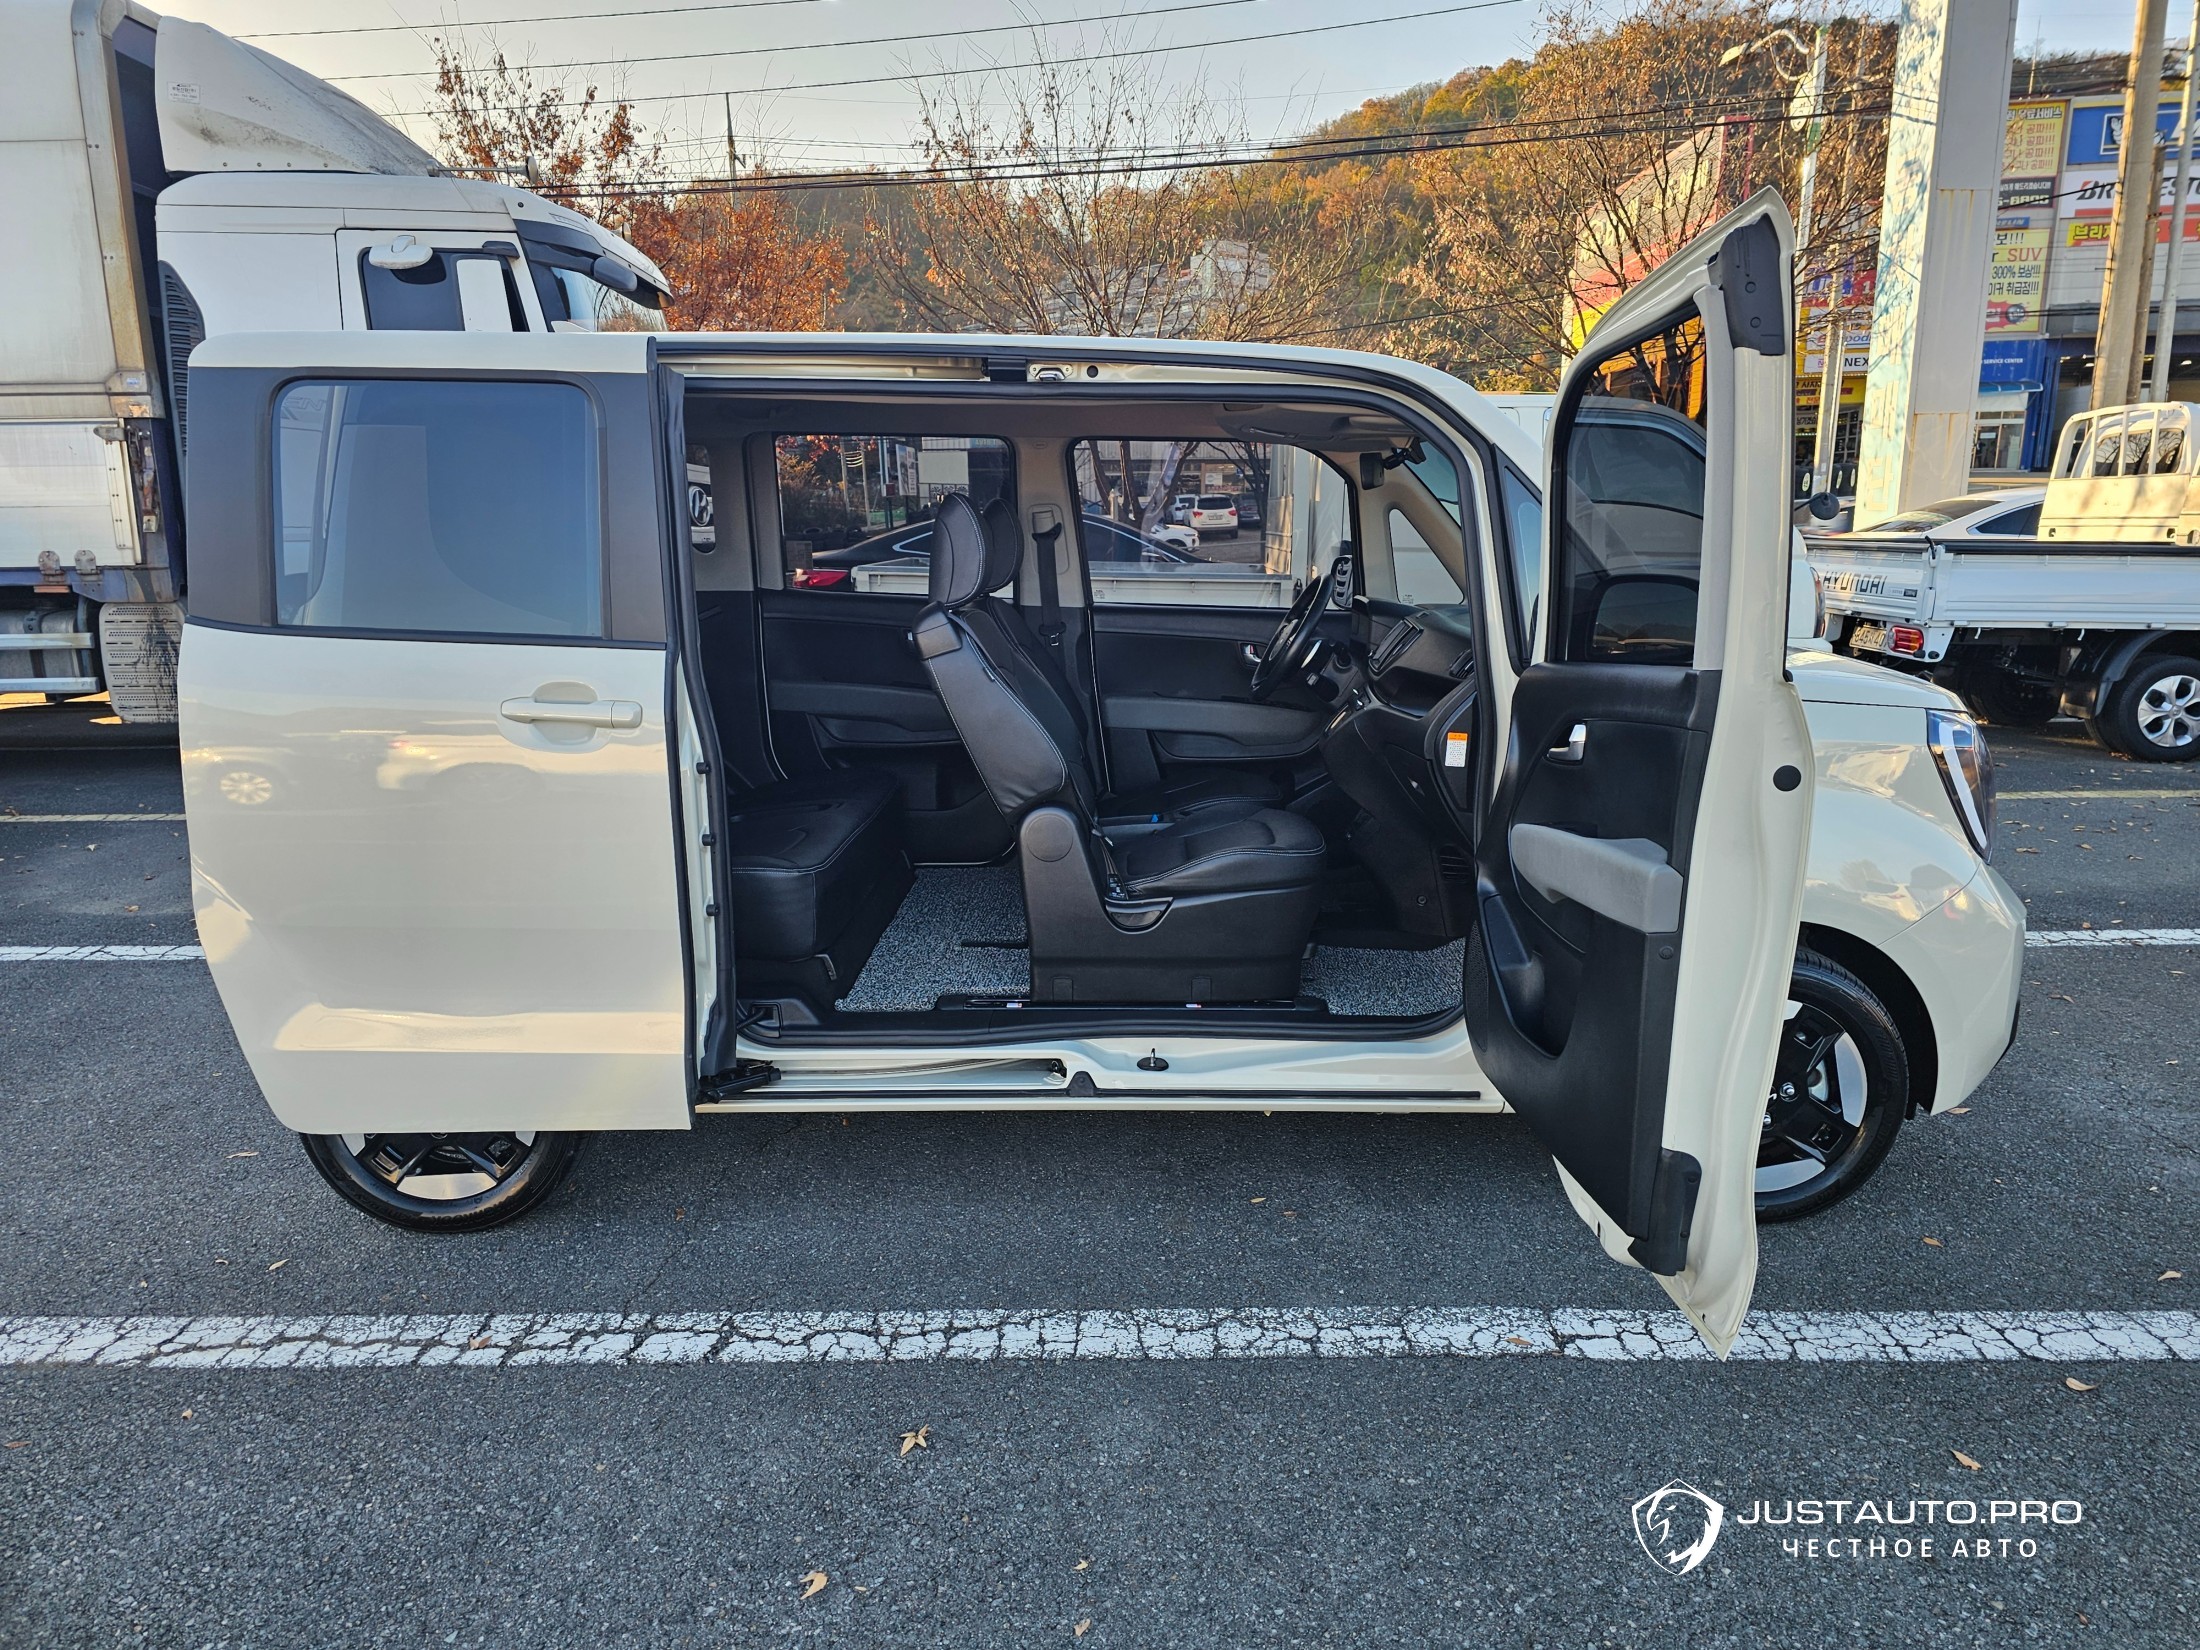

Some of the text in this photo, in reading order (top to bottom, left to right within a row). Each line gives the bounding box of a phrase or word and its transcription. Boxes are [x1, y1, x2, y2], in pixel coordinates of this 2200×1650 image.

[2007, 248, 2042, 262] SUV
[1992, 265, 2015, 279] 300%
[1823, 571, 1888, 595] HYUNDAI
